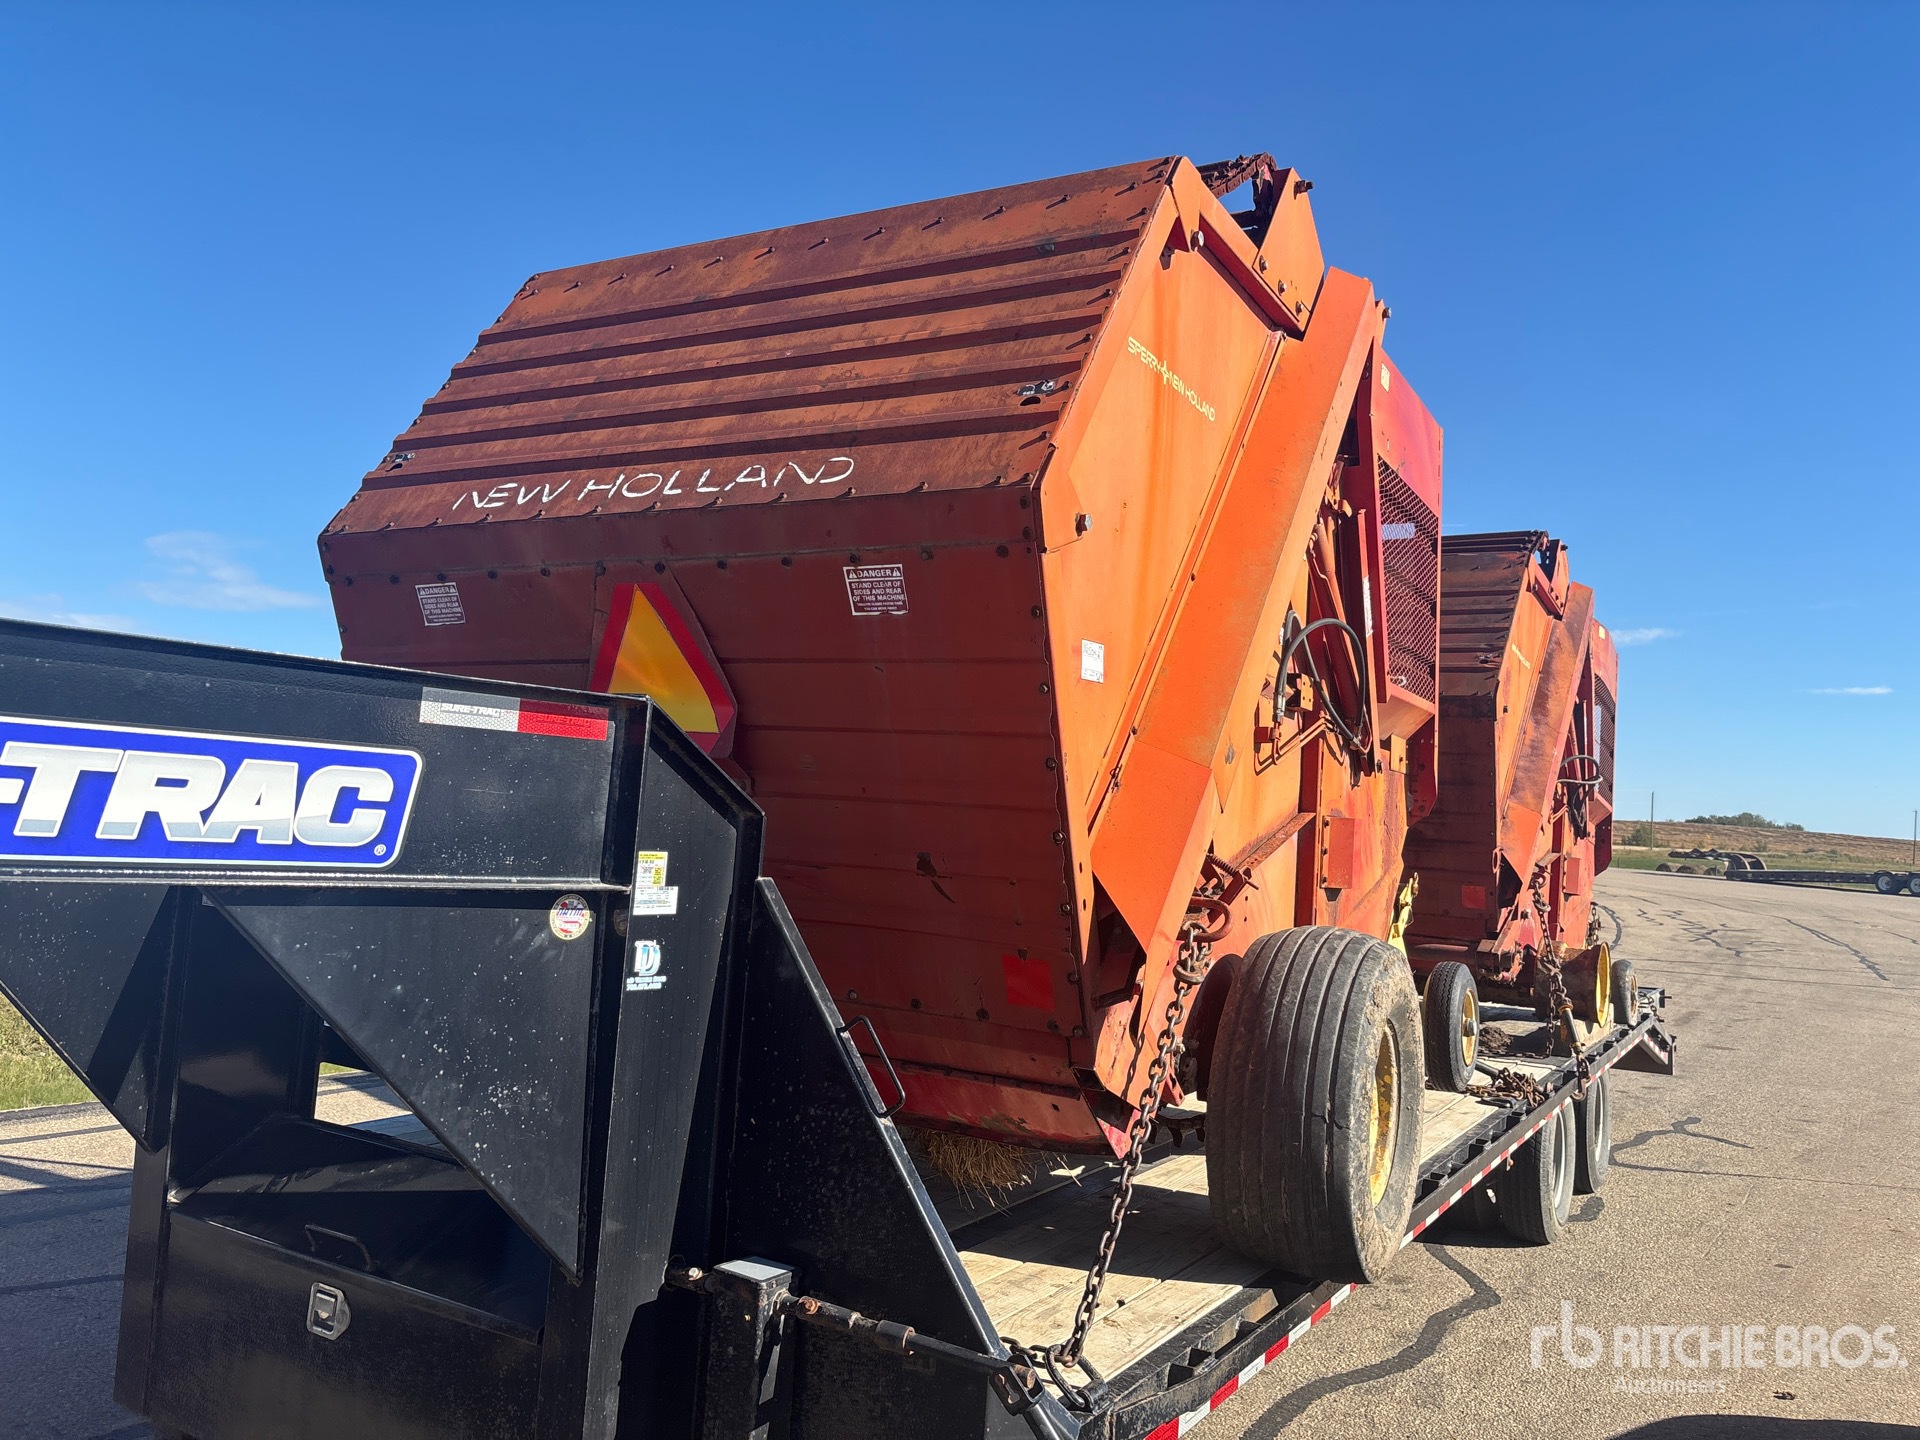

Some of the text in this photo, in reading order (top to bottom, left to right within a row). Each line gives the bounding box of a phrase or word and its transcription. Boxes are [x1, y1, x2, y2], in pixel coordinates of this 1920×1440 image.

[1127, 335, 1161, 375] SPERRY
[1185, 385, 1216, 422] HOLLAND
[452, 456, 855, 511] NEW HOLLAND
[857, 569, 892, 577] DANGER
[425, 587, 449, 595] DANGER
[440, 702, 500, 718] SURE-TRAC
[536, 712, 592, 728] SURE-TRAC
